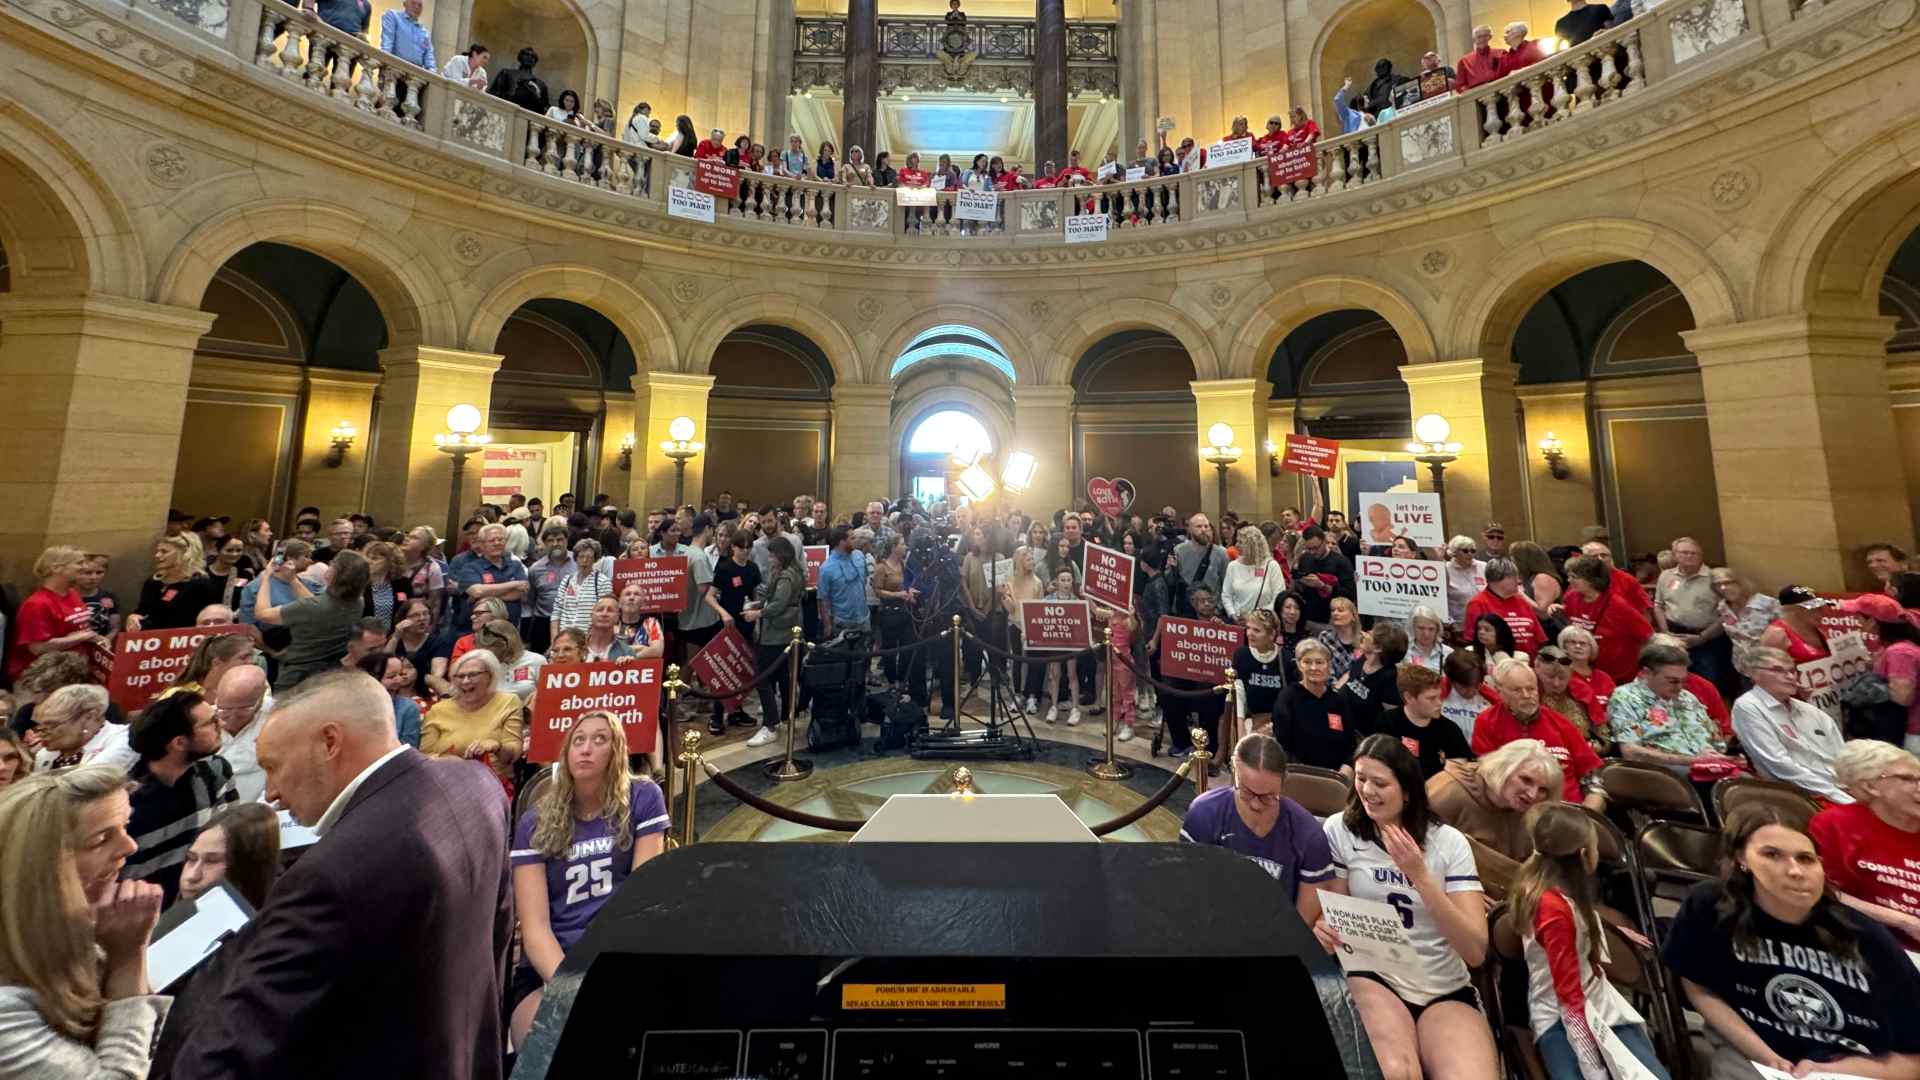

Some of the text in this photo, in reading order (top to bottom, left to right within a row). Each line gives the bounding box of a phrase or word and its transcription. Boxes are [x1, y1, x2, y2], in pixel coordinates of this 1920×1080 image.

[1271, 146, 1312, 163] NO MORE
[699, 161, 737, 176] NO MORE
[1396, 503, 1429, 512] let her
[1394, 513, 1433, 524] LIVE
[1101, 553, 1116, 569] NO
[616, 569, 685, 579] CONSTITUTIONAL
[1090, 563, 1127, 583] ABORTION
[1363, 561, 1438, 582] 12,000
[625, 577, 675, 586] AMENDMENT
[1096, 580, 1118, 595] BIRTH
[1108, 577, 1117, 586] TO
[1362, 579, 1440, 598] TOO MANY
[1044, 606, 1065, 617] NO
[1042, 631, 1072, 639] BIRTH
[1166, 622, 1238, 643] NO MORE
[125, 637, 162, 653] NO
[1176, 640, 1227, 656] abortion
[138, 654, 190, 671] abort
[1171, 650, 1233, 668] up to birth
[127, 671, 176, 688] up to
[546, 668, 655, 689] NO MORE
[1249, 672, 1282, 689] JESUS
[560, 692, 636, 711] abortion
[549, 716, 573, 732] up
[567, 835, 616, 861] UNW
[565, 857, 613, 905] 25
[1902, 892, 1919, 905] to
[1333, 908, 1370, 923] WOMAN'S
[1371, 916, 1400, 929] PLACE
[1387, 892, 1414, 930] 6
[1338, 918, 1350, 928] ON
[1352, 920, 1367, 931] THE
[1345, 928, 1359, 937] ON
[1360, 930, 1376, 940] THE
[1780, 941, 1871, 994] ROBERTS
